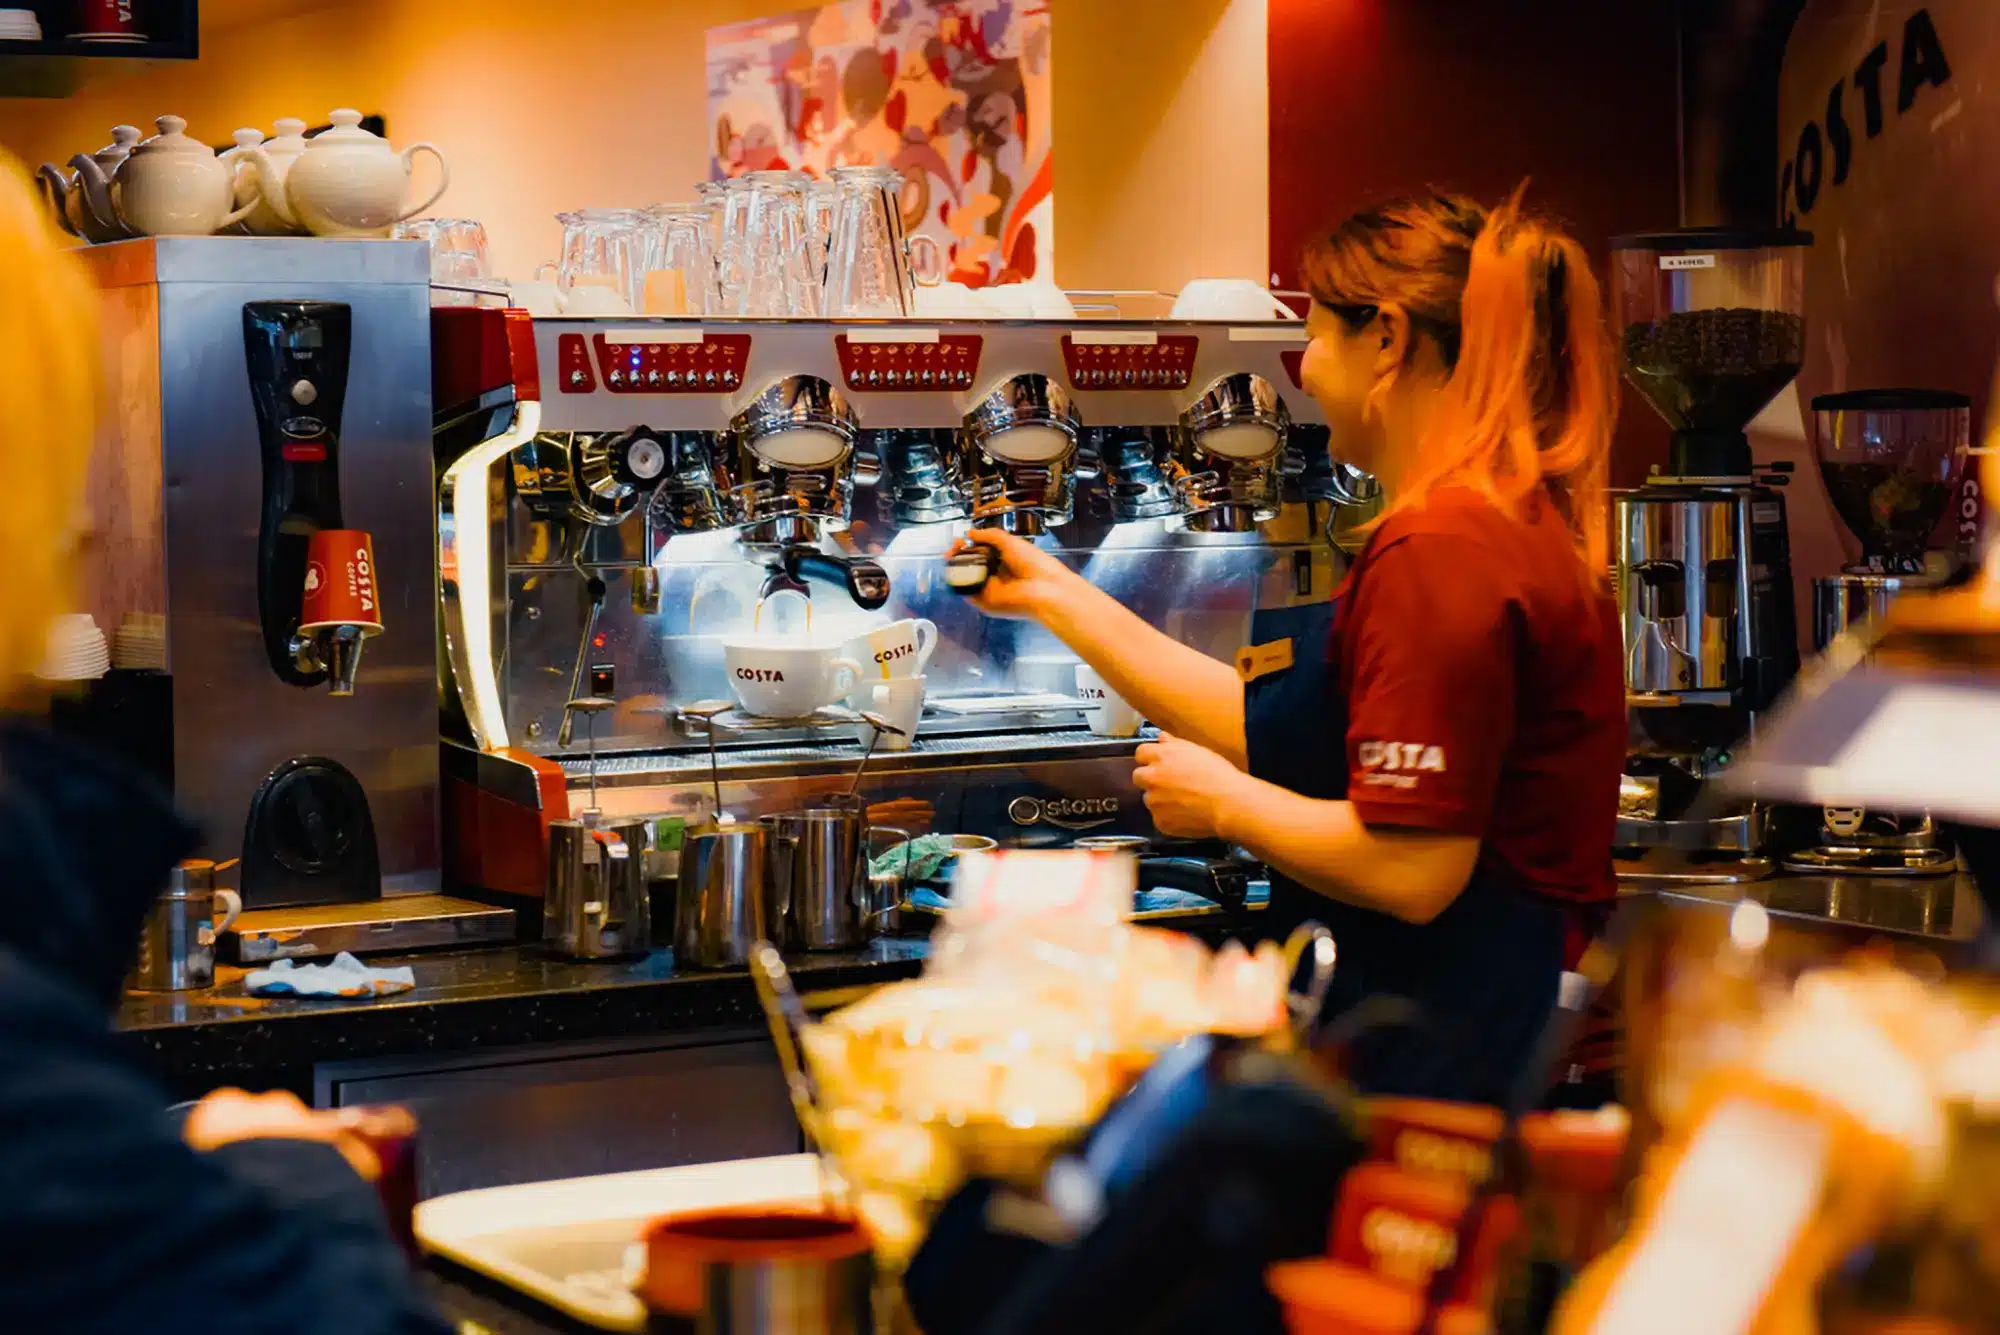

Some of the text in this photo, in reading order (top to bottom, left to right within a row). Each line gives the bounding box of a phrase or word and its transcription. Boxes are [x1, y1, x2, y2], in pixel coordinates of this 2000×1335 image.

[356, 548, 374, 612] COSTA
[874, 643, 914, 664] COSTA
[736, 667, 785, 683] COSTA
